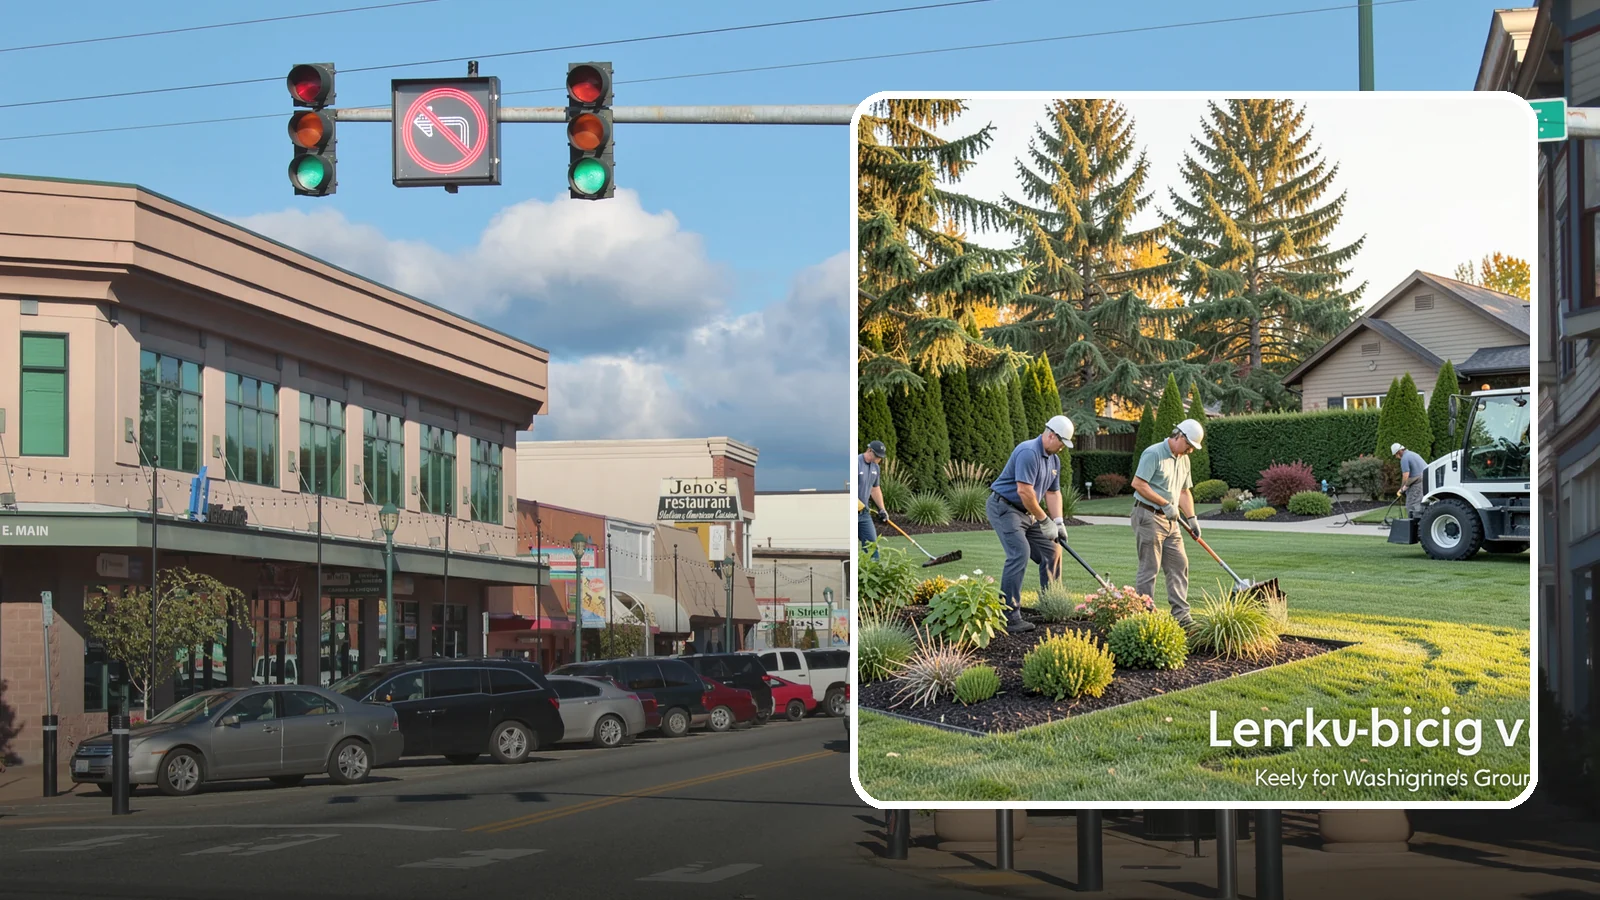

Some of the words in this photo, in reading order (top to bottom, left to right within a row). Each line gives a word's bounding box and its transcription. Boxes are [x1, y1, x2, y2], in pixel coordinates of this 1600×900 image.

[670, 480, 727, 494] Jeno's
[665, 496, 731, 509] restaurant
[686, 509, 714, 519] American
[715, 509, 737, 519] Cuisine
[2, 525, 13, 536] E.
[15, 525, 49, 536] MAIN
[797, 607, 828, 616] Street
[790, 619, 823, 627] lass
